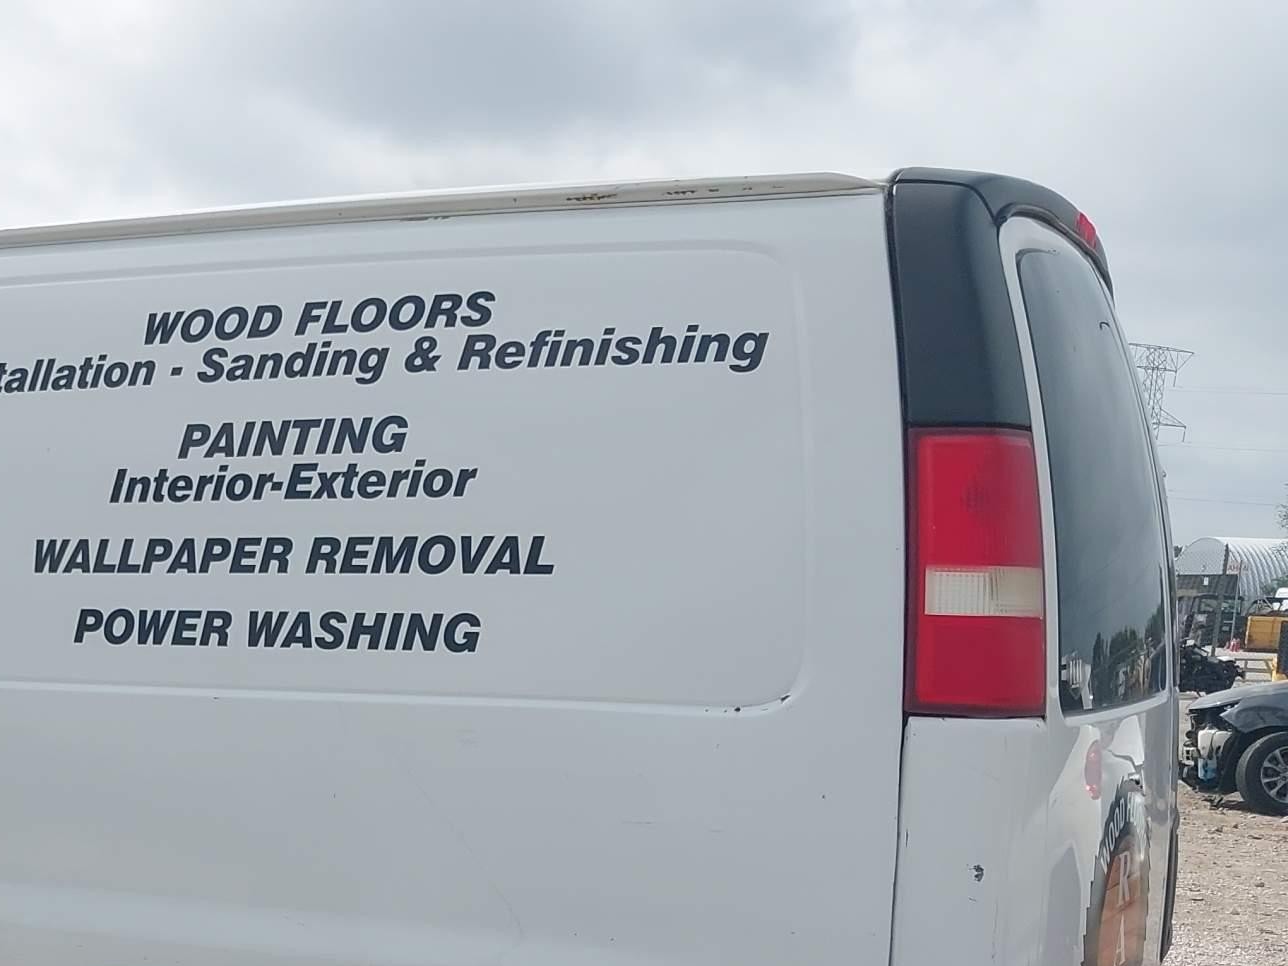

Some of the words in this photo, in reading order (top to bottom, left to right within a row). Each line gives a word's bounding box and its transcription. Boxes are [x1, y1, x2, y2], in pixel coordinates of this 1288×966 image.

[144, 304, 283, 345] WOOD
[294, 291, 496, 336] FLOORS
[170, 366, 184, 377] -
[197, 341, 389, 385] Sanding
[404, 335, 441, 373] &
[456, 325, 769, 373] Refinishing
[177, 415, 409, 459] PAINTING
[109, 459, 478, 503] Interior-Exterior
[33, 537, 294, 574] WALLPAPER
[305, 535, 554, 574] REMOVAL
[73, 608, 232, 647] POWER
[247, 611, 481, 653] WASHING
[1100, 797, 1125, 875] WOOD
